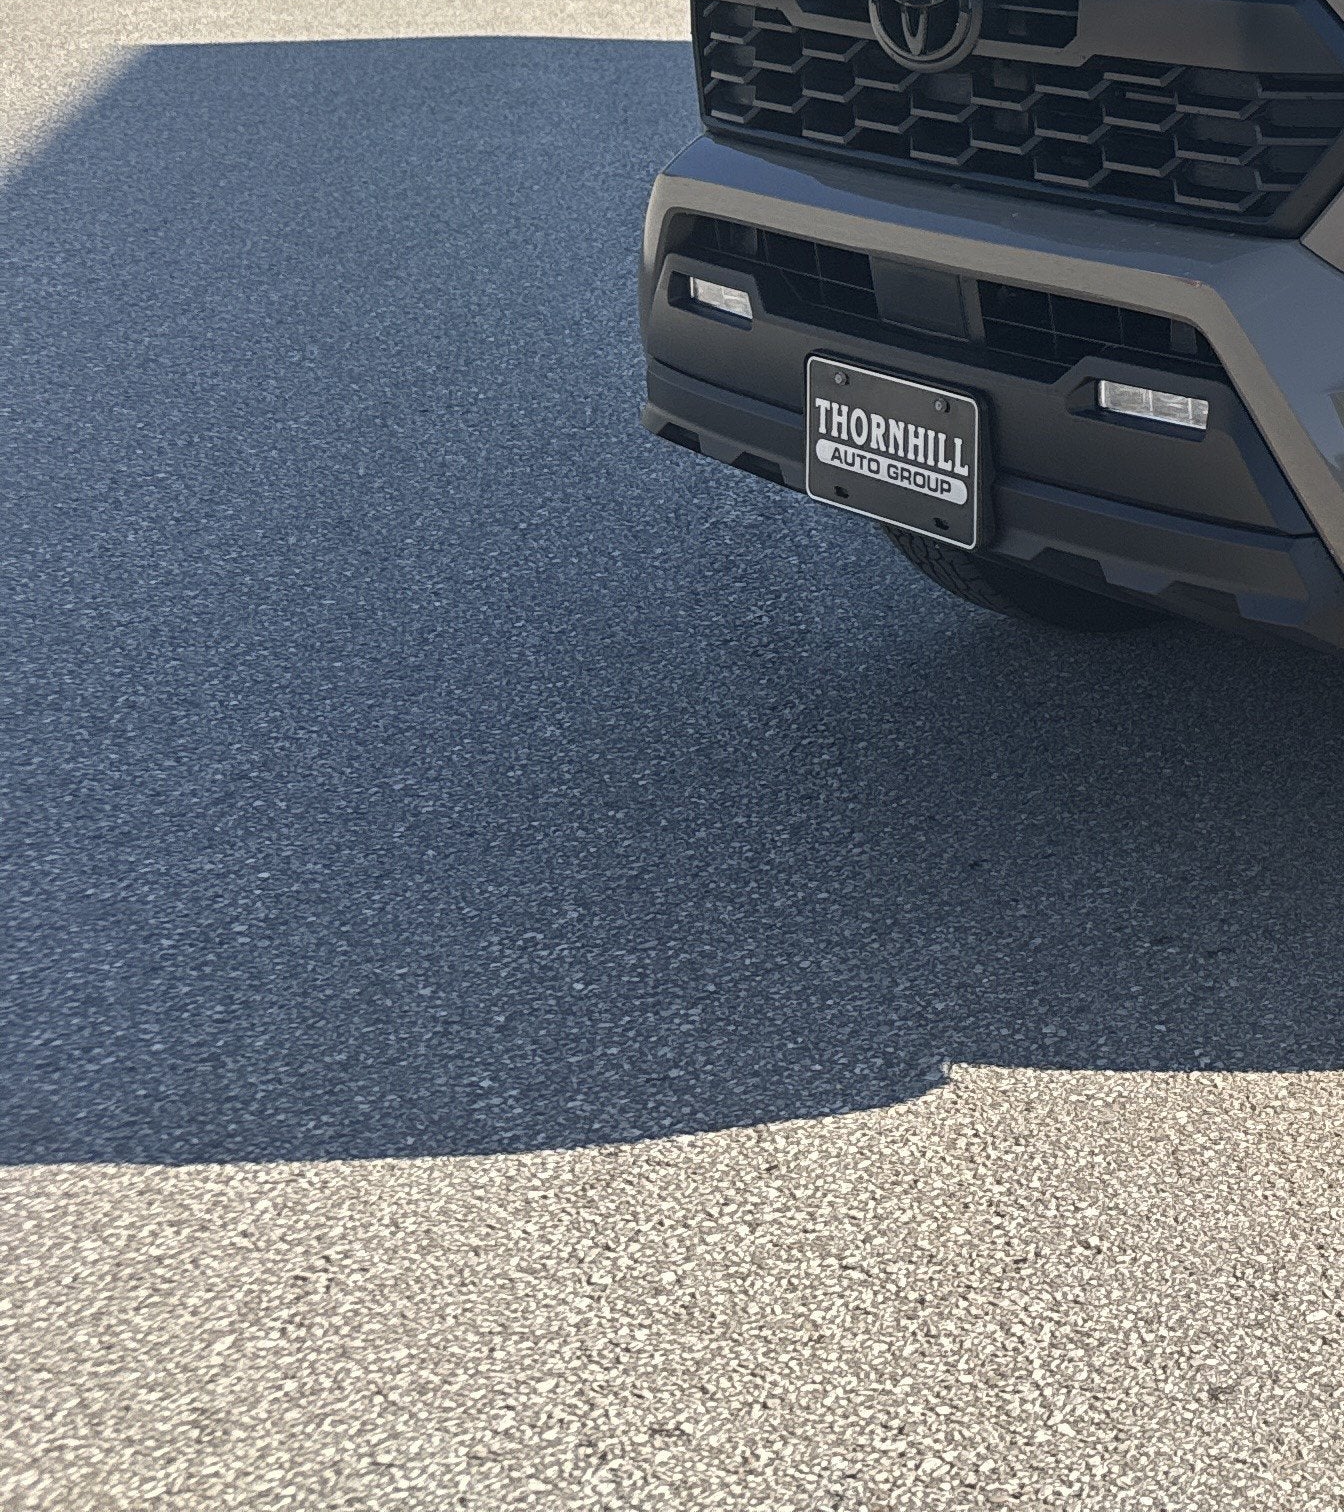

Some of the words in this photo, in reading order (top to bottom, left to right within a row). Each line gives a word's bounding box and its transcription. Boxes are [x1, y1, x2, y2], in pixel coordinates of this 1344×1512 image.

[815, 397, 969, 476] THORNHILL
[830, 446, 881, 476] AUTO
[886, 462, 952, 496] GROUP
